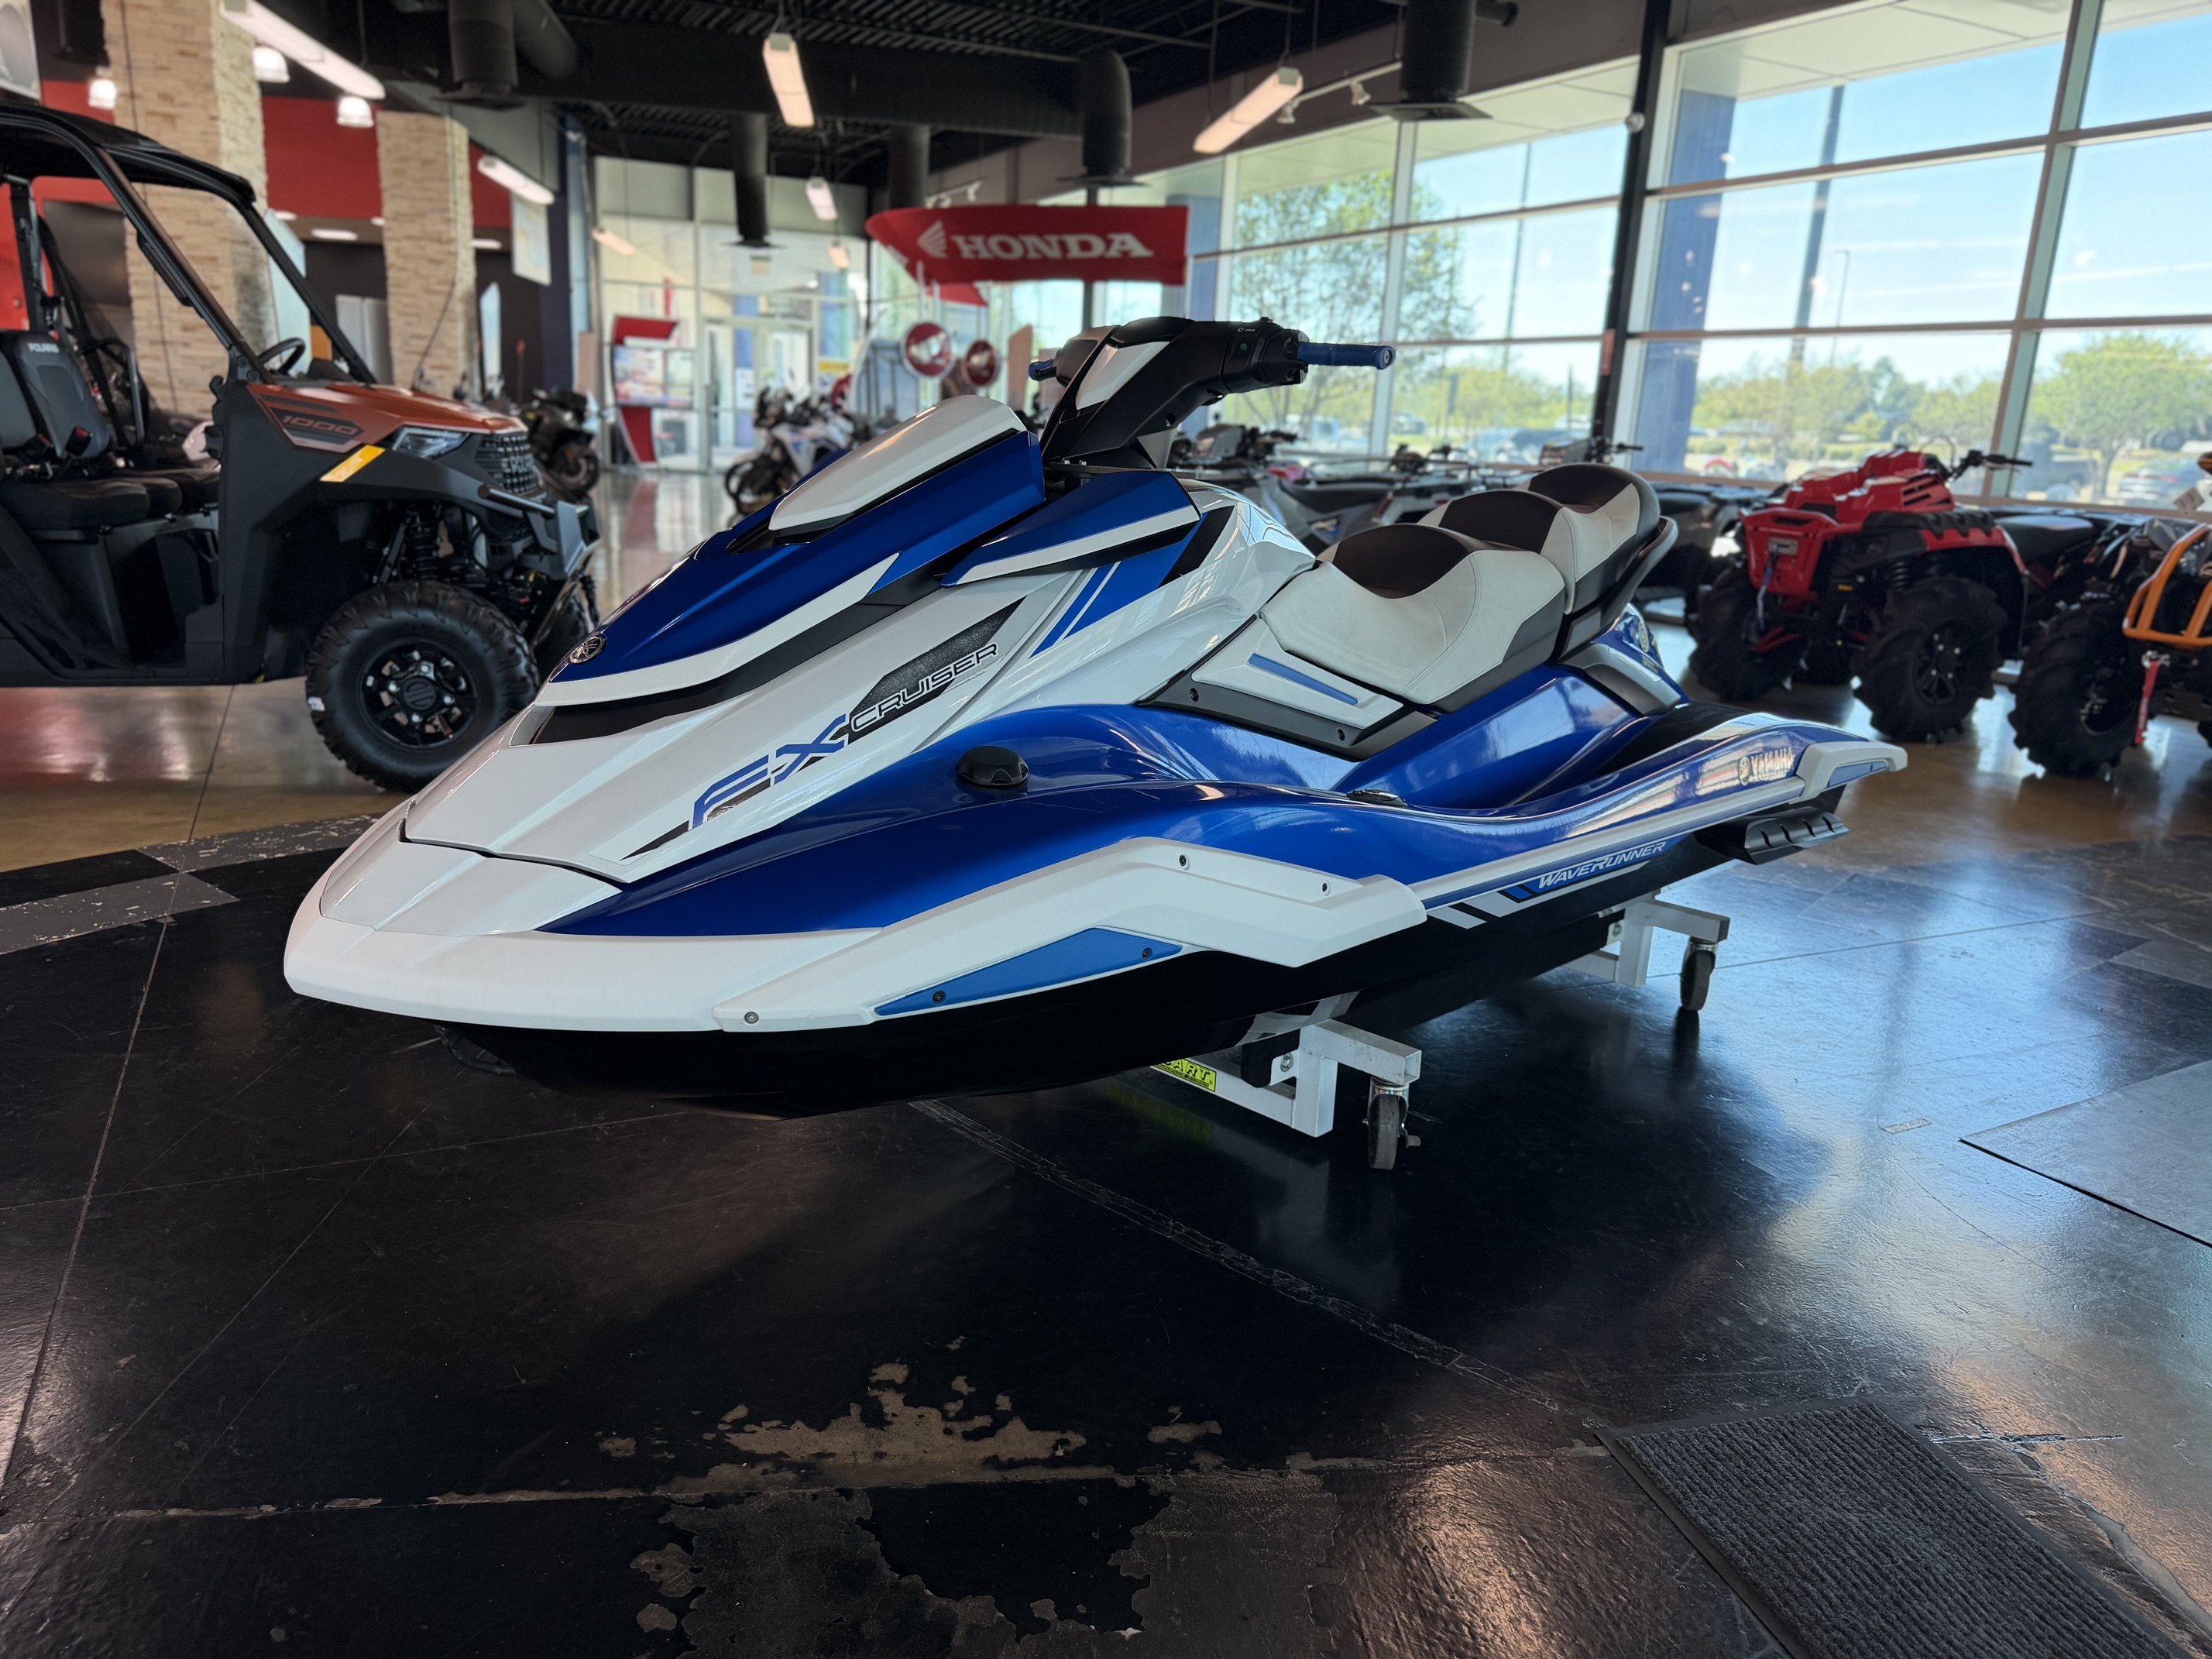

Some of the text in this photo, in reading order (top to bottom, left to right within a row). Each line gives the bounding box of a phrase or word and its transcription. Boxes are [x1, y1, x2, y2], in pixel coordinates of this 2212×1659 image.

[951, 233, 1154, 259] HONDA
[282, 415, 358, 435] 1000
[692, 641, 1000, 829] FX CRUISER
[1538, 841, 1667, 889] WAVERUNNER
